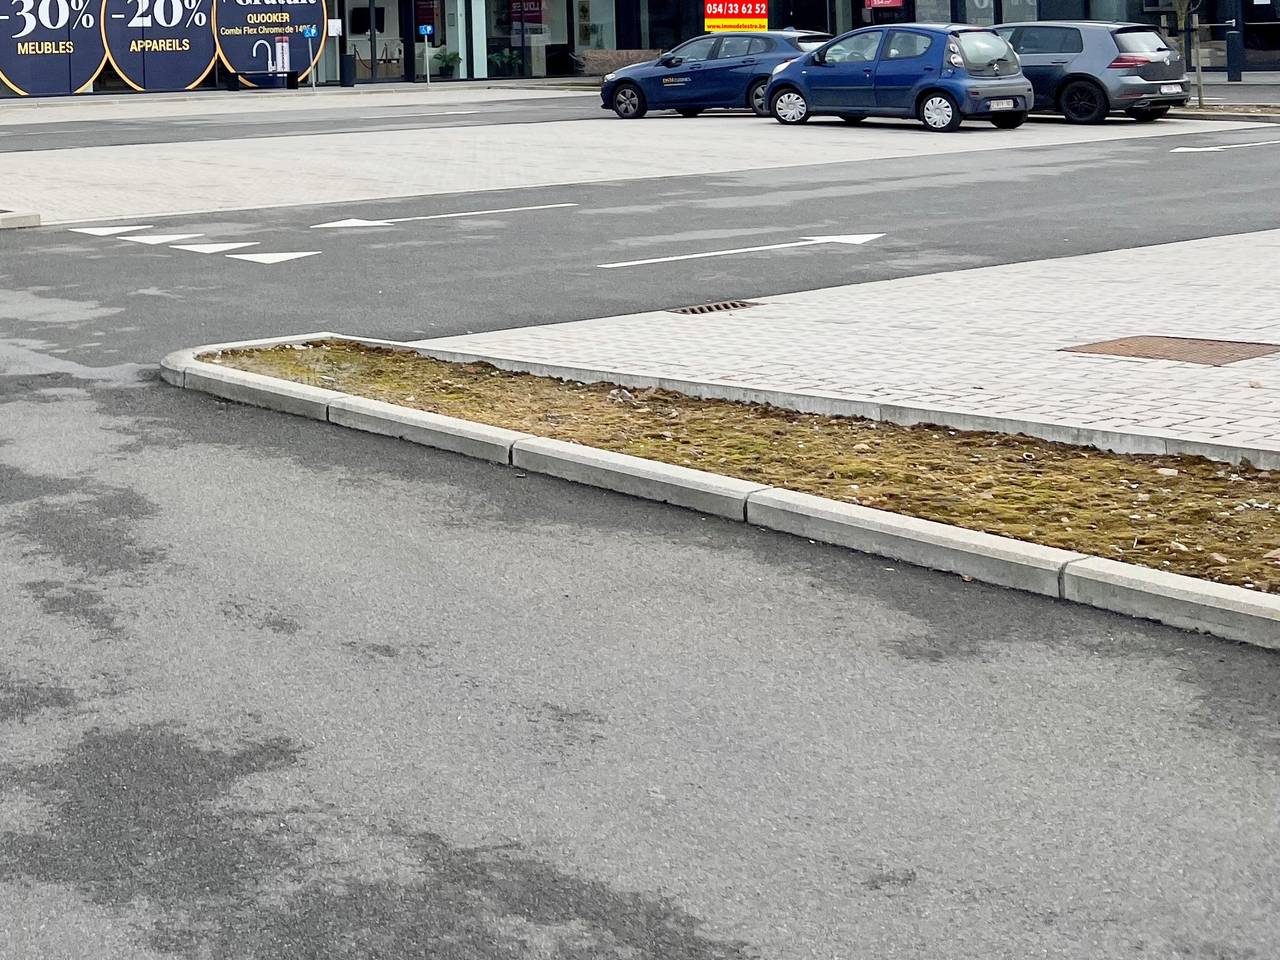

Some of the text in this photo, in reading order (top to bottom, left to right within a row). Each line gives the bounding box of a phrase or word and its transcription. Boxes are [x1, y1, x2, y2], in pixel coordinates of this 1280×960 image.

[246, 12, 290, 24] QUOOKER
[220, 26, 242, 36] Combi
[243, 26, 257, 35] Flex
[286, 25, 294, 33] de
[17, 41, 74, 54] MEUBLES
[130, 39, 190, 52] APPAREILS
